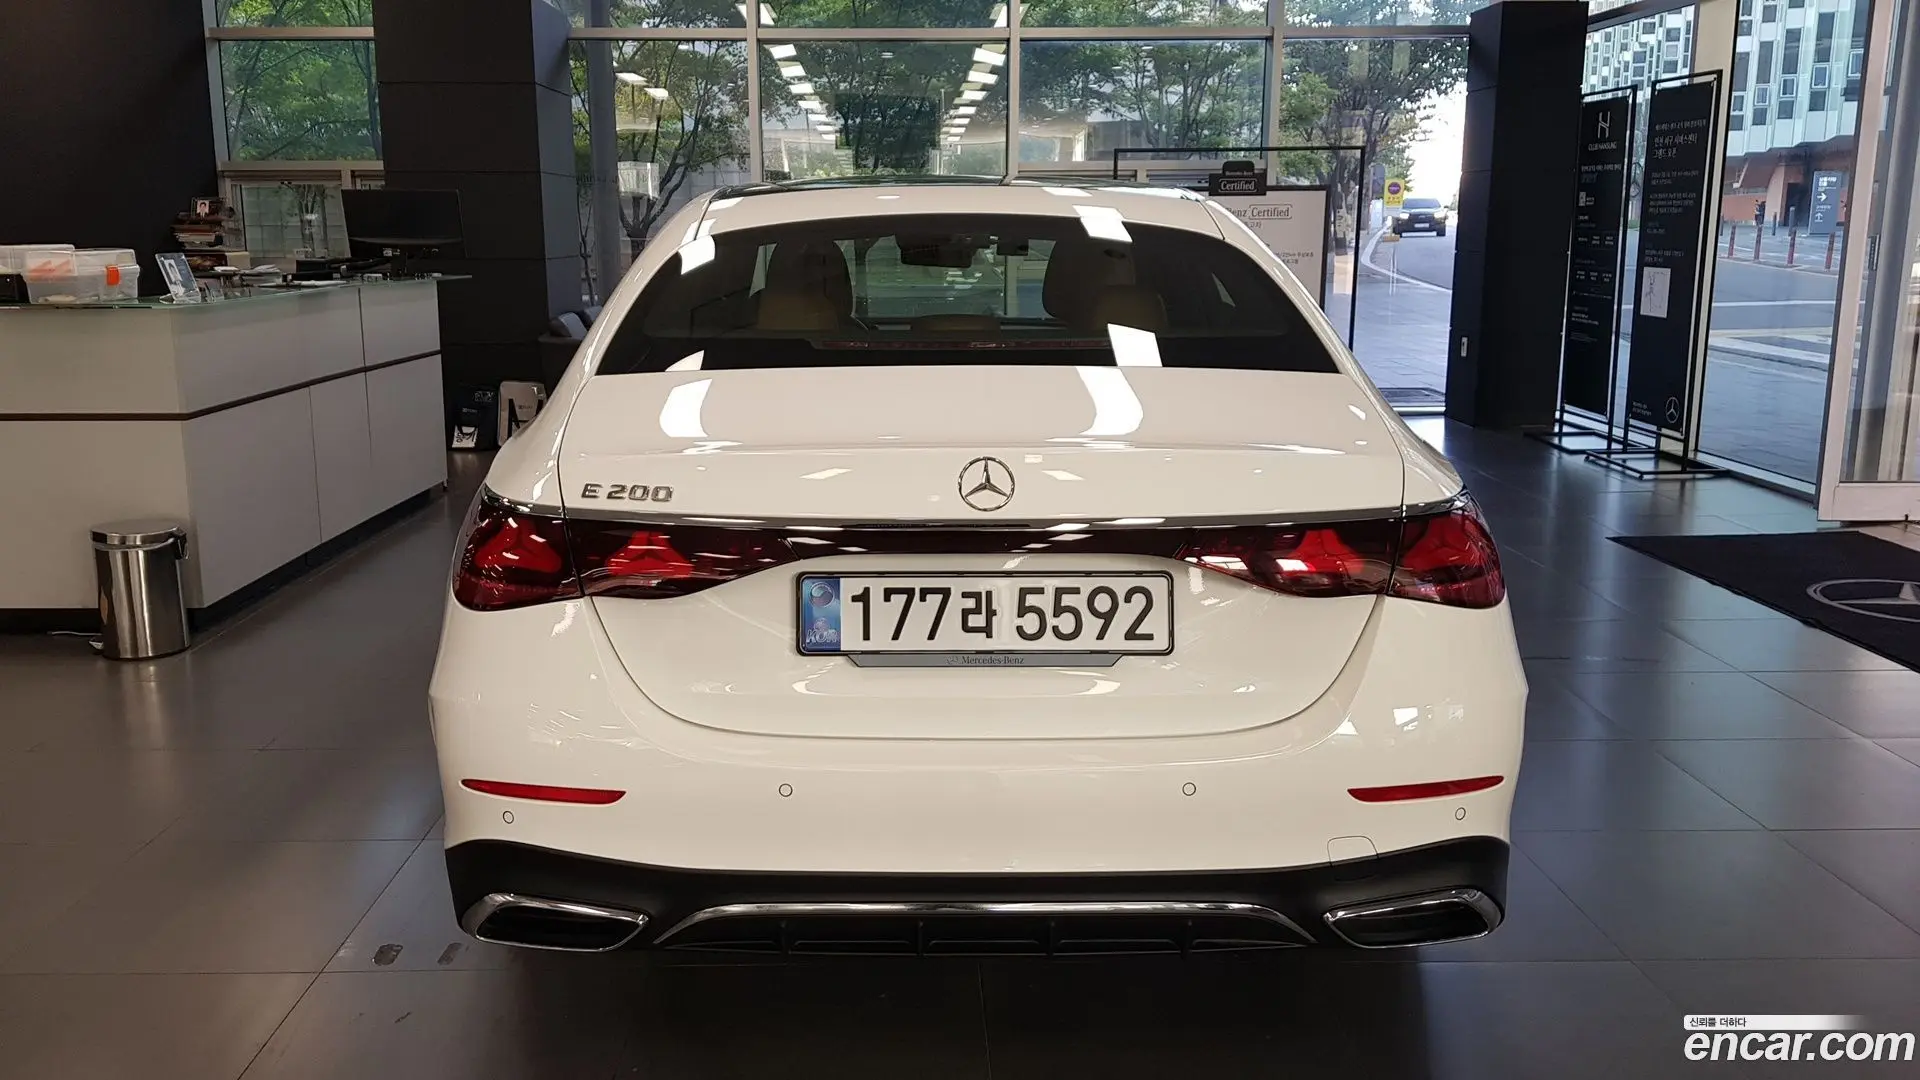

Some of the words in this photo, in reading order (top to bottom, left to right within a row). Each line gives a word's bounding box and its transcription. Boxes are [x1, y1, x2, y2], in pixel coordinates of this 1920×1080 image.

[1221, 181, 1255, 191] Certified
[1251, 207, 1290, 217] Certified
[581, 483, 603, 499] E
[606, 484, 673, 502] 200
[850, 586, 998, 641] 177라
[1015, 586, 1155, 641] 5592
[961, 655, 1025, 665] Mercedes-Benz
